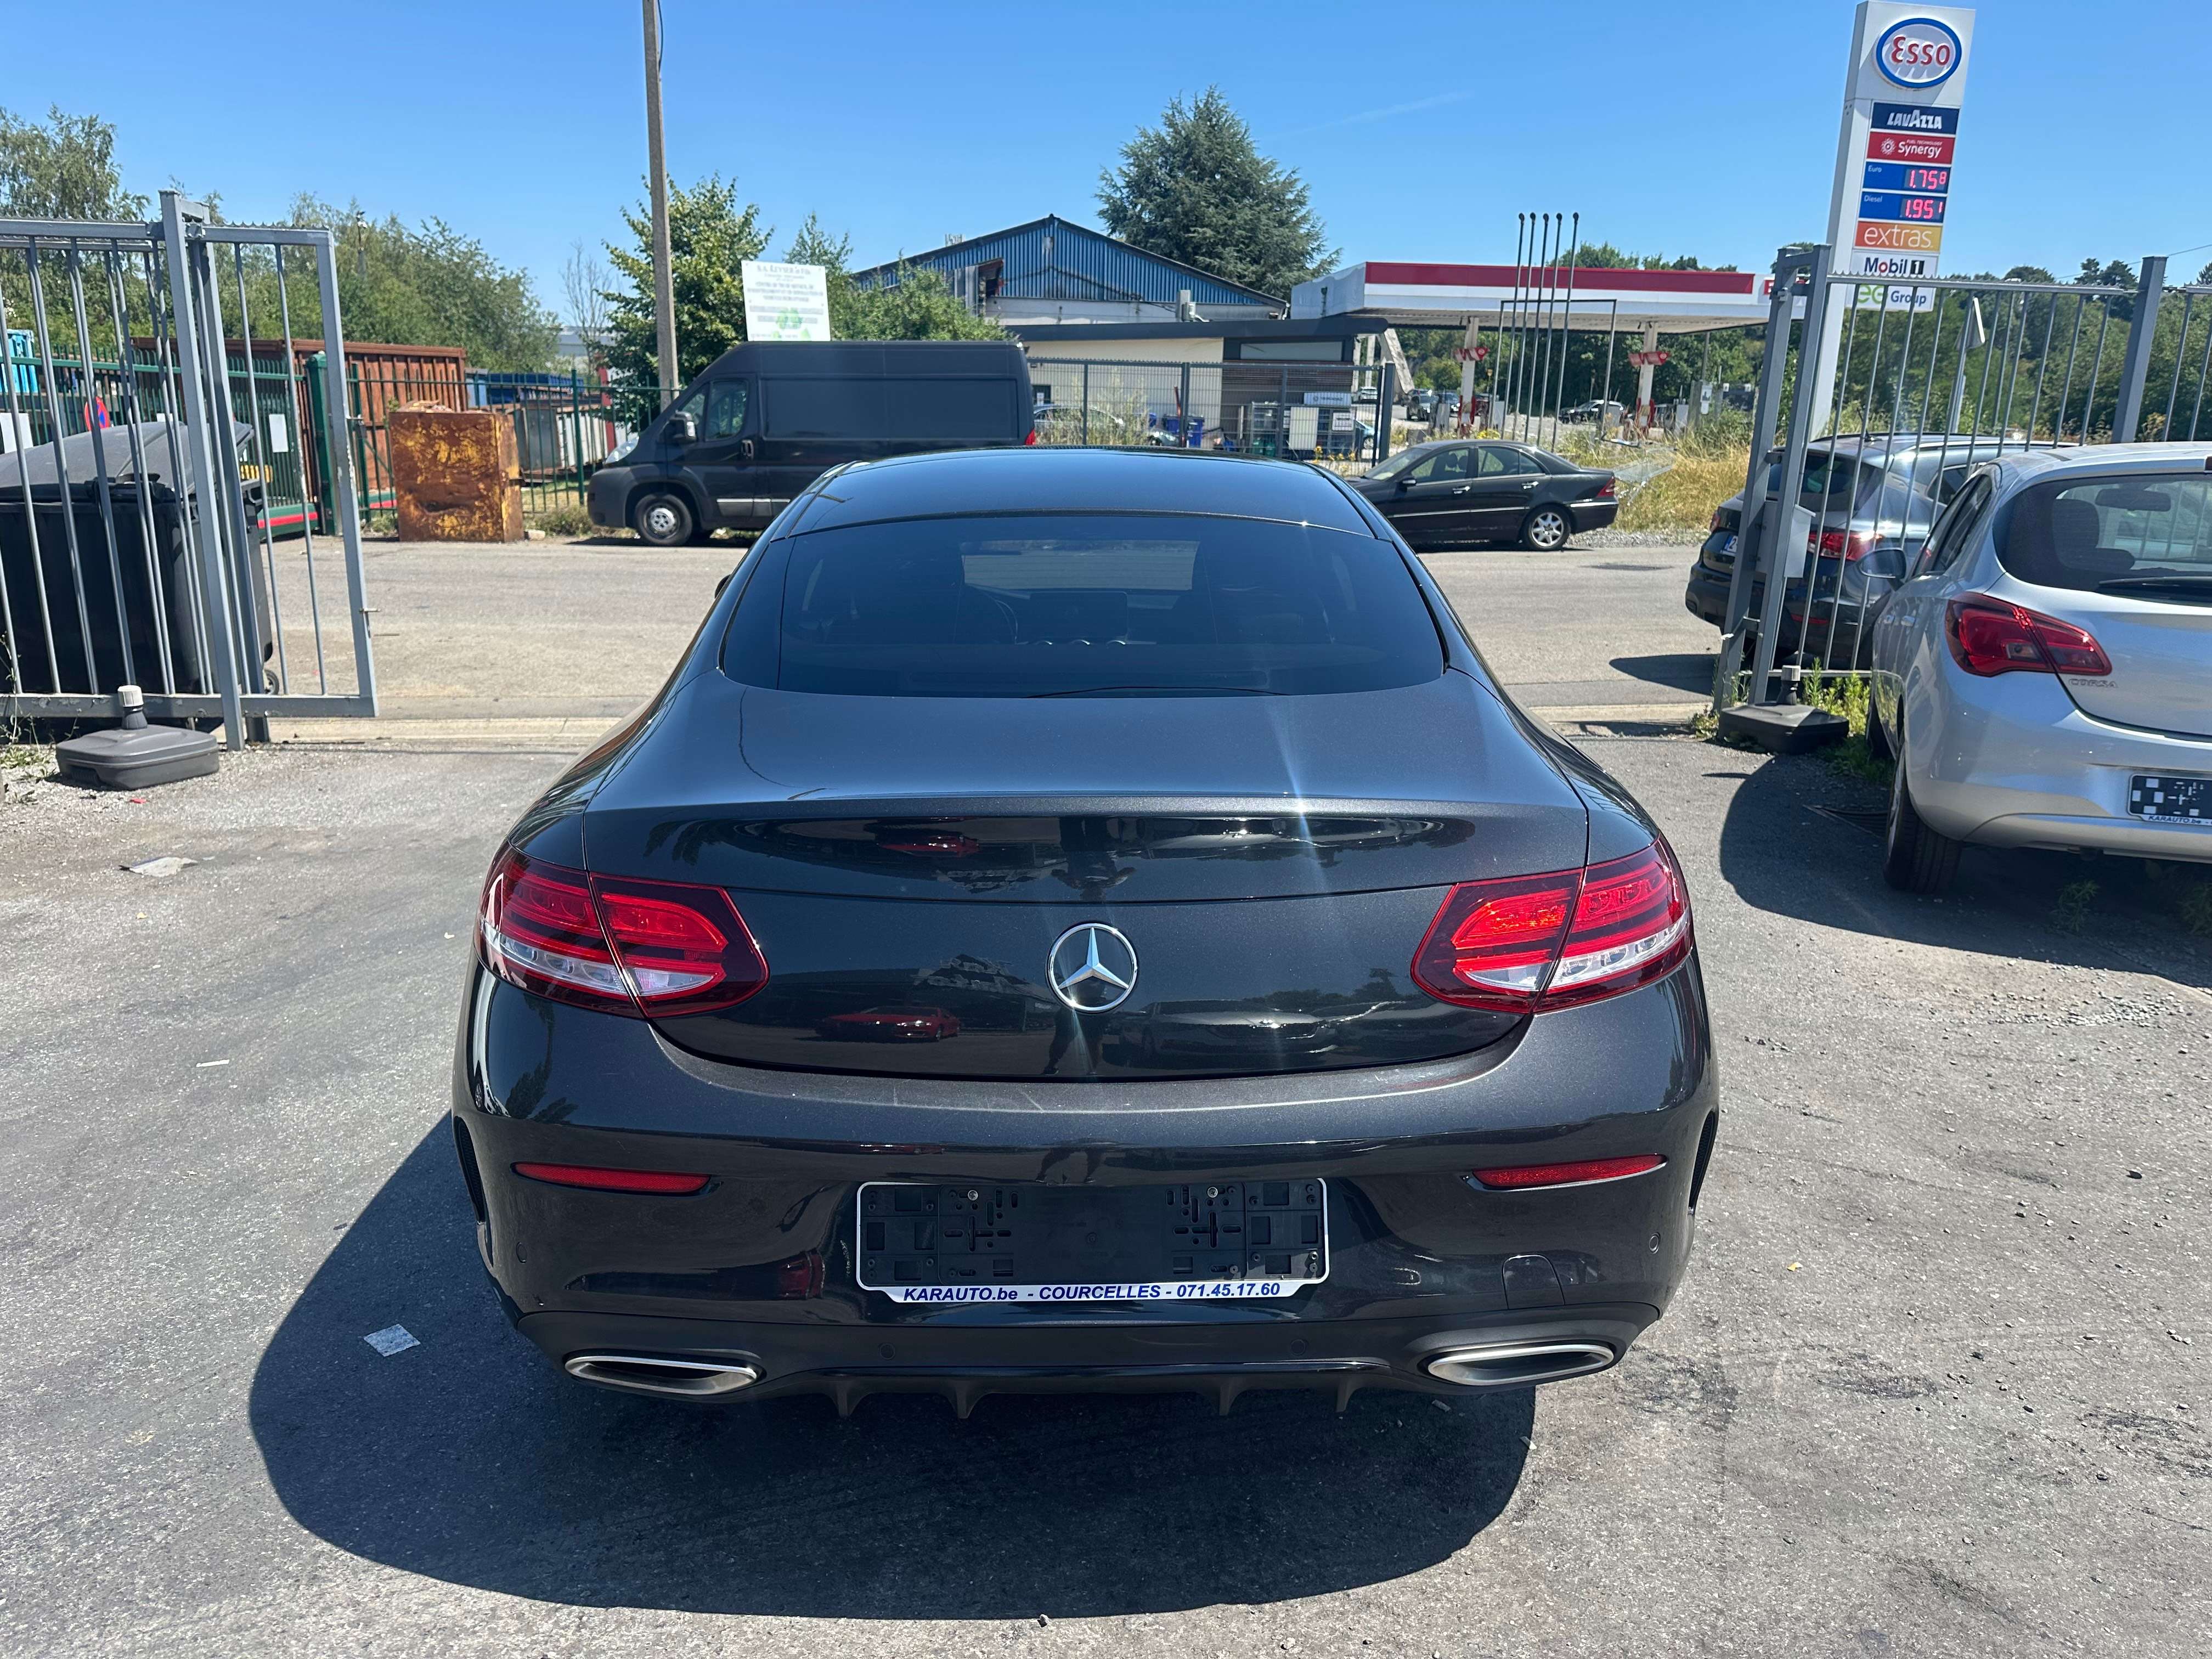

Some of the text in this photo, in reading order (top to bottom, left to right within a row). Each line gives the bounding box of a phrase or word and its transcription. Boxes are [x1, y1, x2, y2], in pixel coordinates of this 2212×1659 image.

[1887, 109, 1942, 130] LAVAZZA
[1898, 142, 1942, 159] Synergy
[1867, 165, 1882, 173] Euro
[1864, 257, 1908, 275] Mobil
[2068, 678, 2118, 688] CORSA
[903, 1287, 1018, 1301] KARAUTO.be
[1039, 1284, 1161, 1300] COURCELLES
[1176, 1282, 1280, 1297] 071.45.17.60
